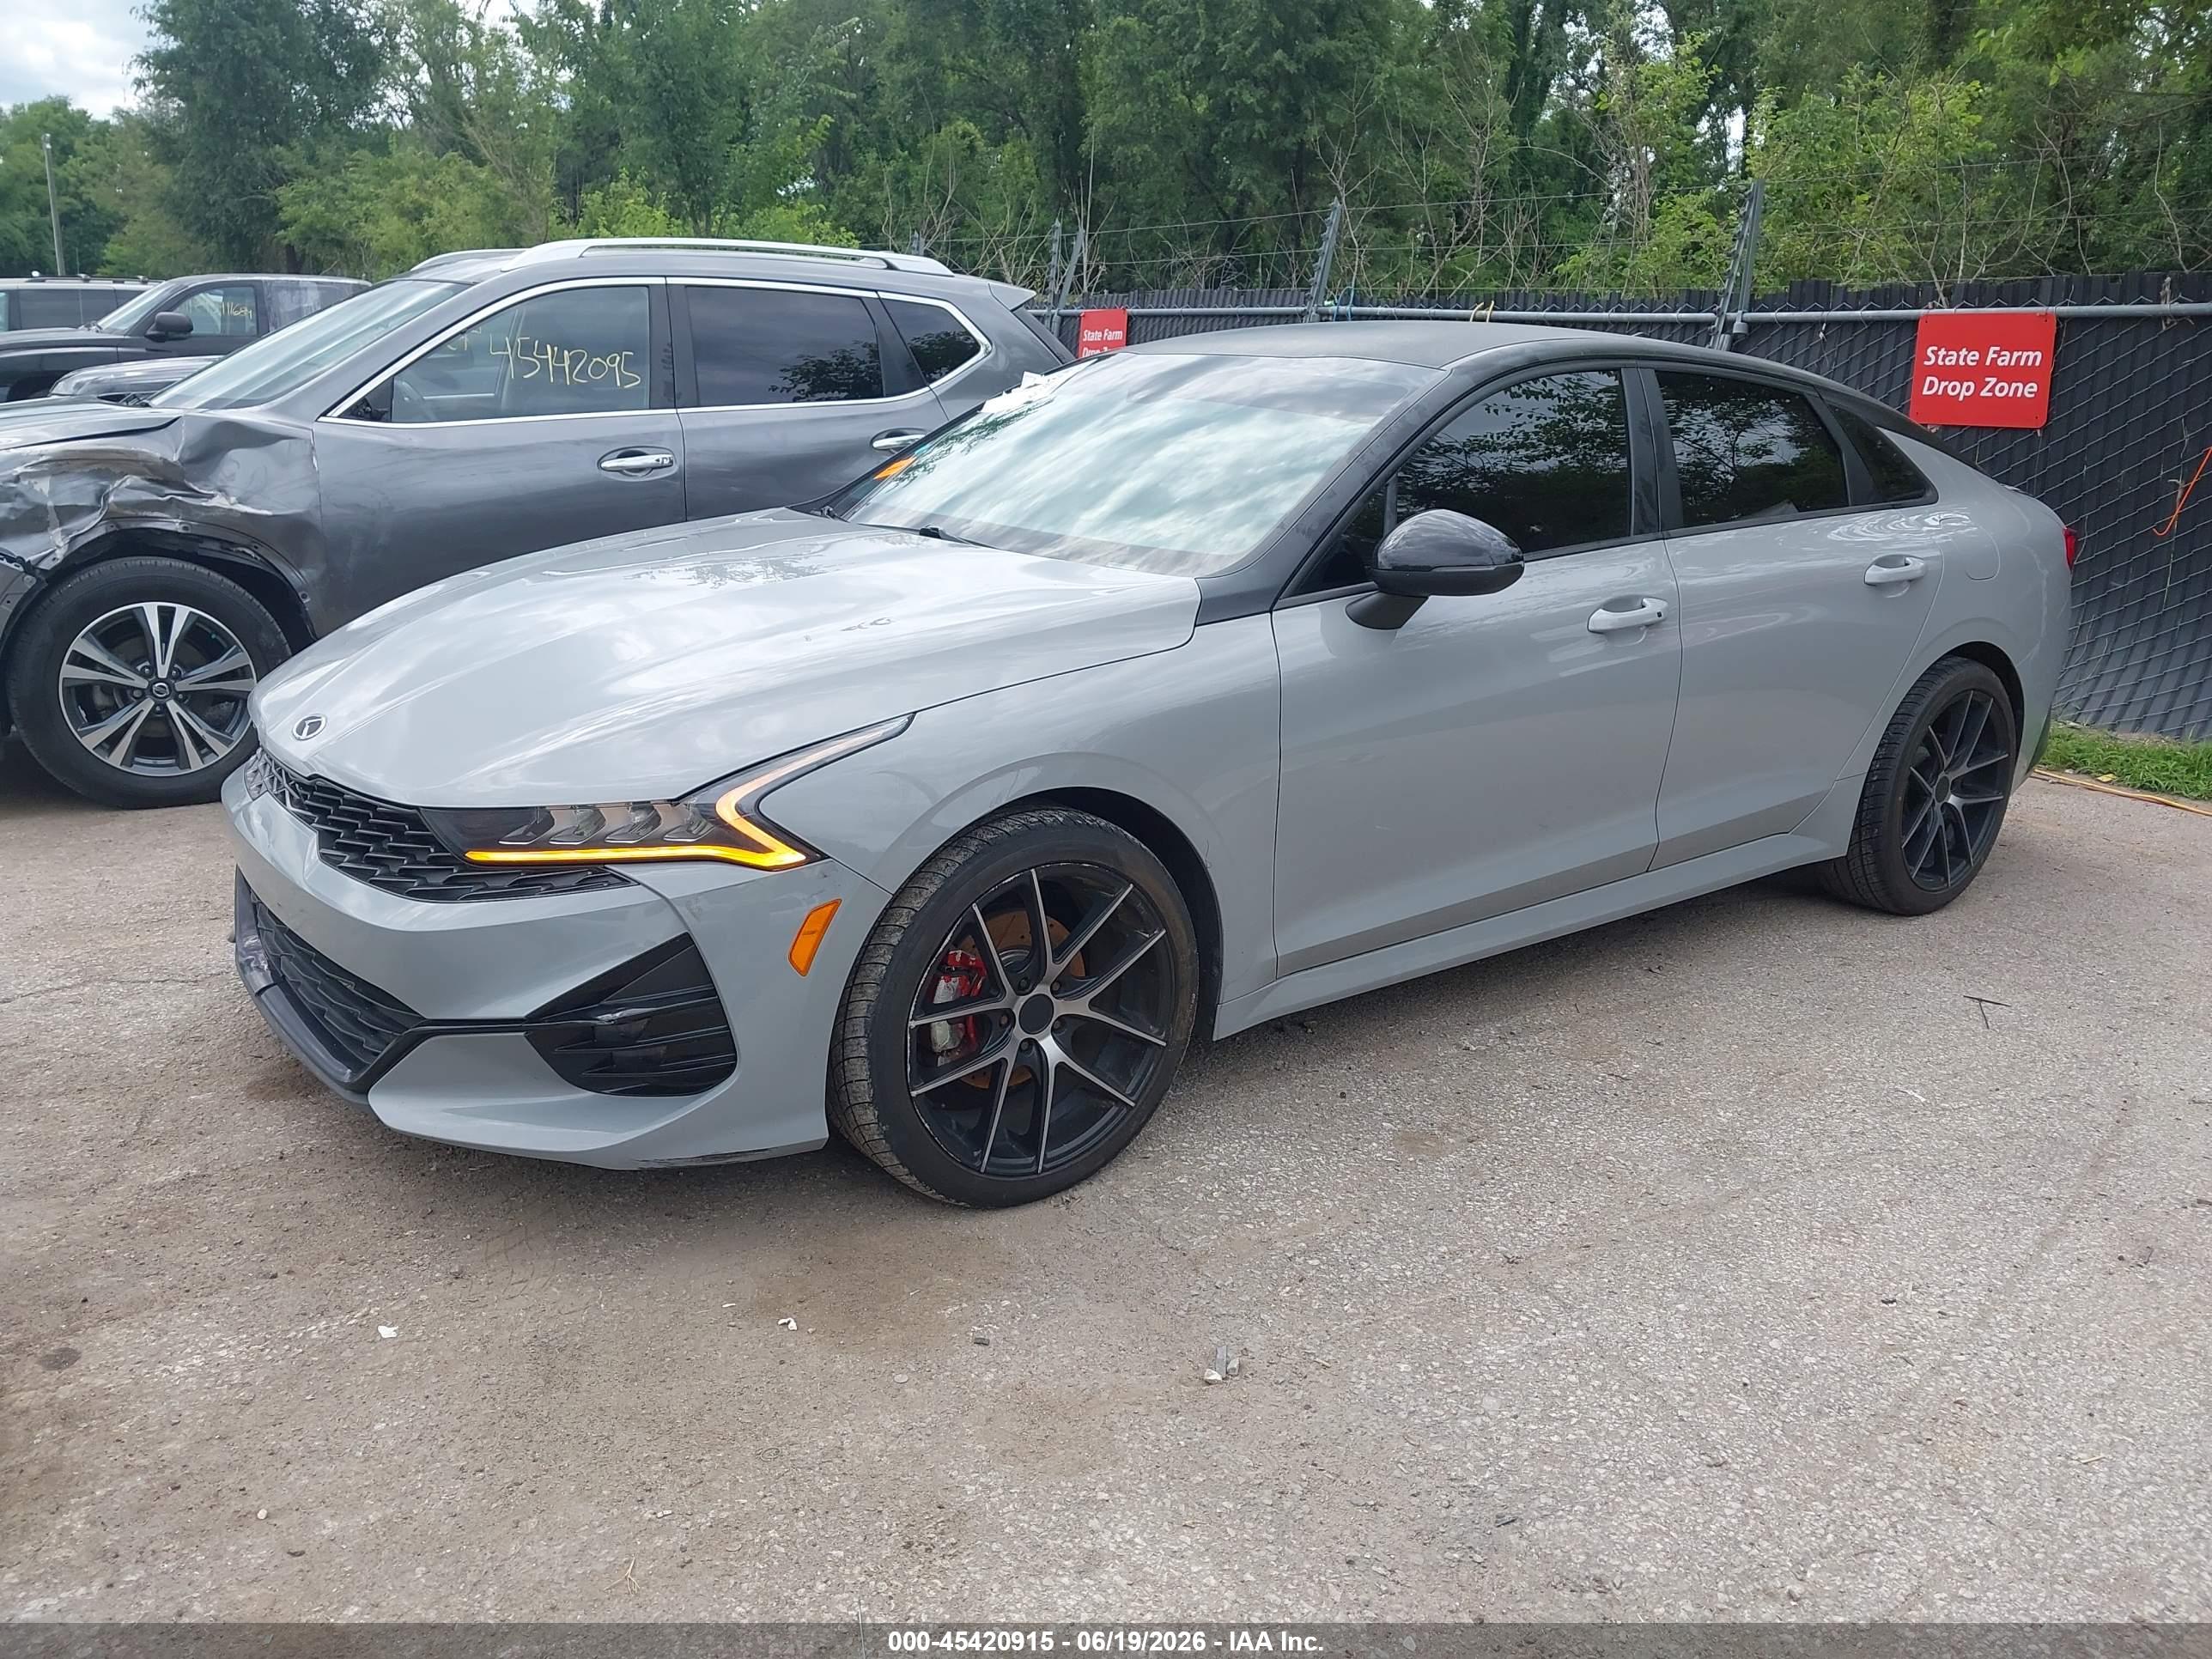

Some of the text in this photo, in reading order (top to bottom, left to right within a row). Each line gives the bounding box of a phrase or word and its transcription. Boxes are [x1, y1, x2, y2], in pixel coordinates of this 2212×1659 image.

[1083, 329, 1122, 341] State Farm
[489, 333, 641, 388] 45442095
[1923, 346, 2042, 367] State Farm
[1922, 376, 2039, 401] Drop Zone
